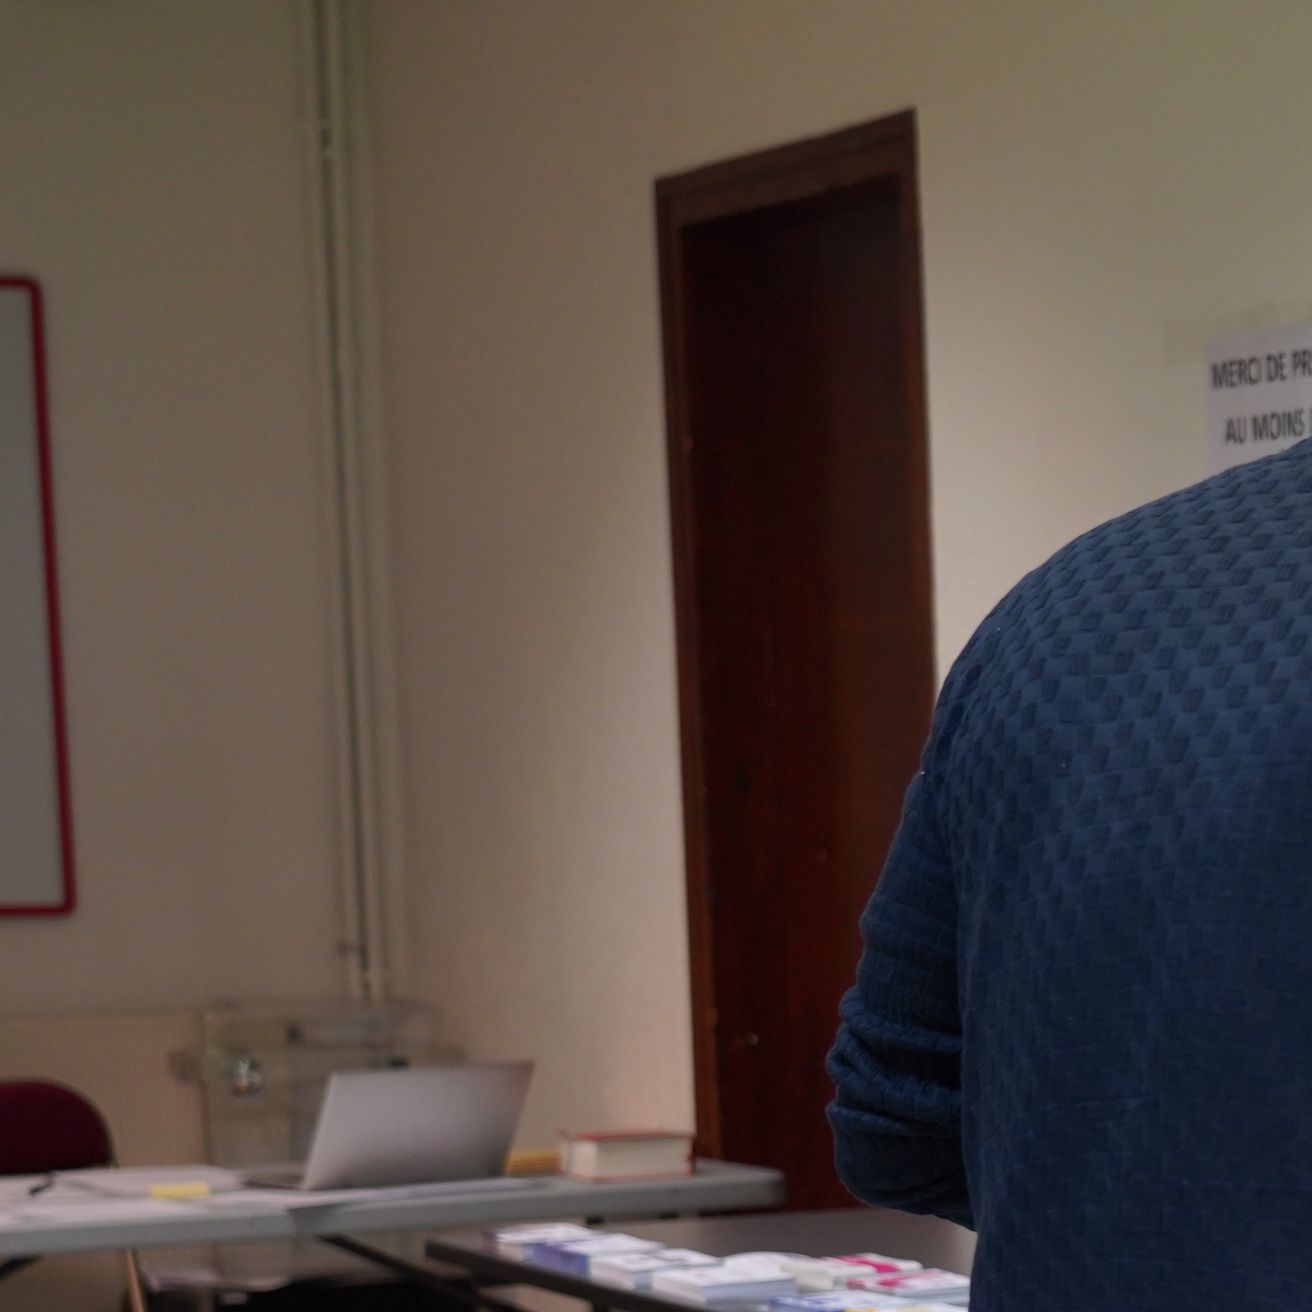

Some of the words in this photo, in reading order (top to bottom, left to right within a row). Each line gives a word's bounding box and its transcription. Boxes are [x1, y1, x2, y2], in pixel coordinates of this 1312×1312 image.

[1212, 355, 1262, 388] MERCI
[1266, 351, 1287, 383] DE
[1225, 413, 1248, 445] AU
[1253, 407, 1305, 442] MOINS
